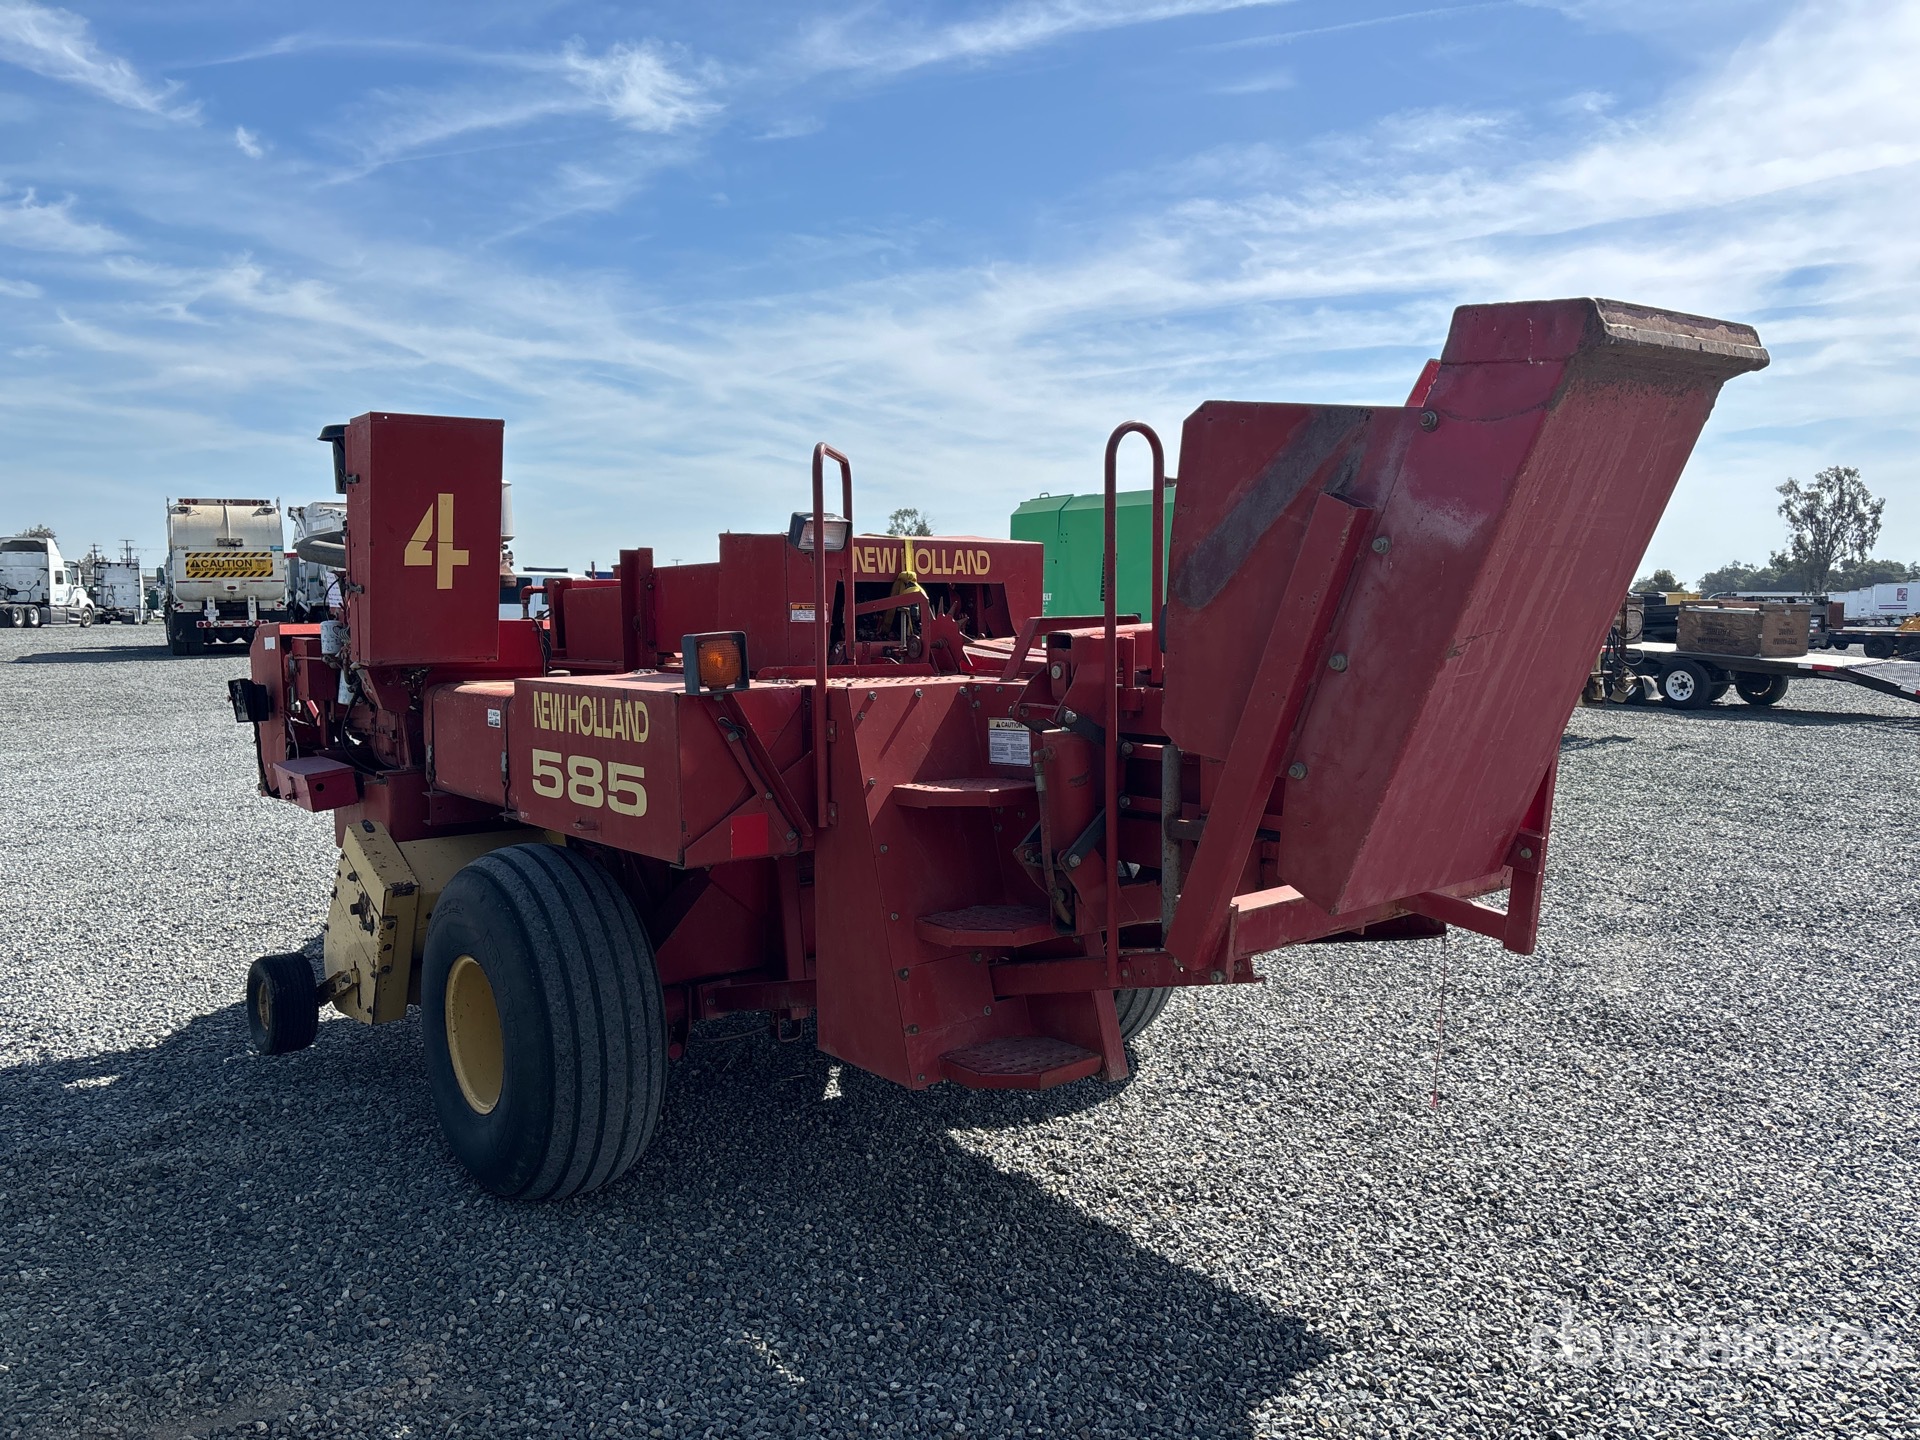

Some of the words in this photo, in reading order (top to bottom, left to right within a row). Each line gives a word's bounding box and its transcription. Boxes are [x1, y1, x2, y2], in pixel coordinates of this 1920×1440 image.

[404, 493, 469, 589] 4
[853, 546, 897, 574] NEW
[200, 559, 252, 568] CAUTION
[533, 691, 565, 732] NEW
[568, 694, 649, 743] HOLLAND
[1000, 721, 1023, 729] CAUTION
[532, 748, 648, 817] 585
